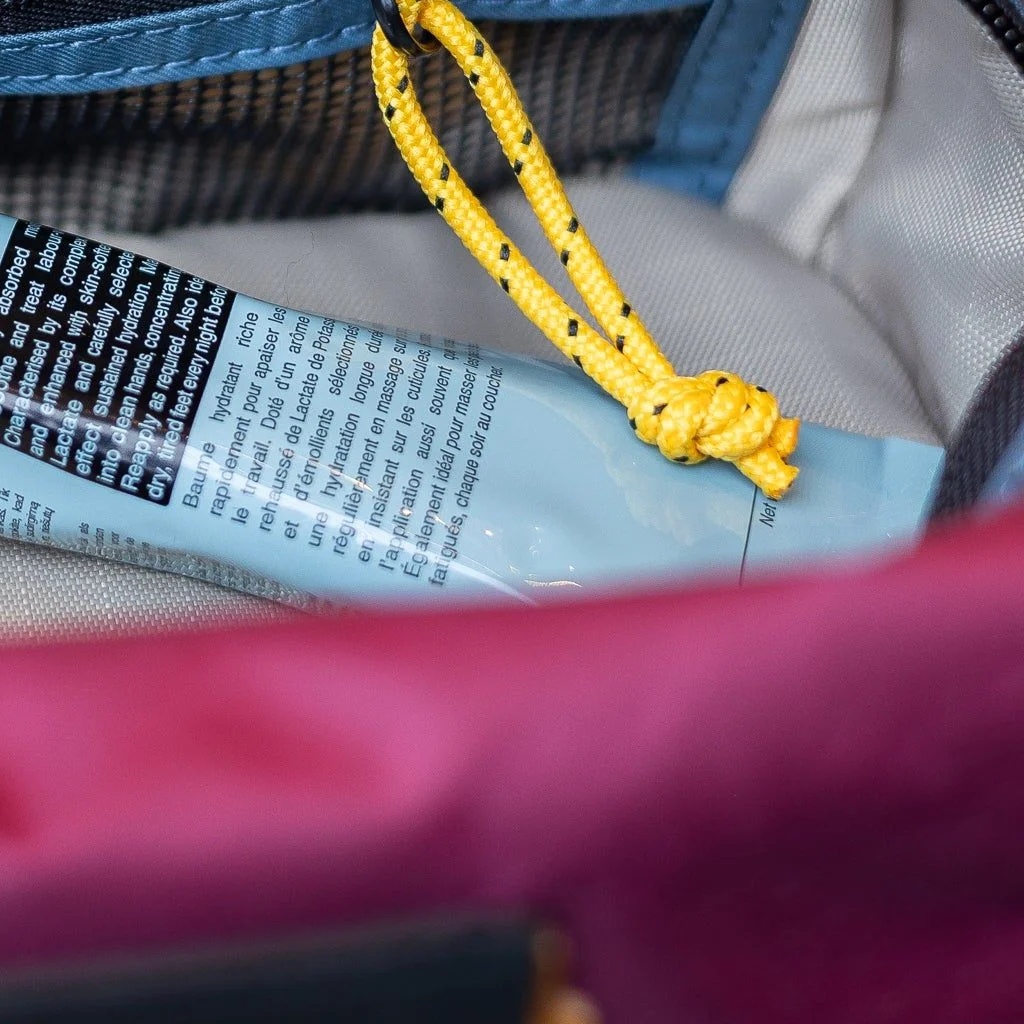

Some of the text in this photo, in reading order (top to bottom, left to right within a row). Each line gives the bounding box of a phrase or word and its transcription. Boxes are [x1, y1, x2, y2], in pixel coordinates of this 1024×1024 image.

[10, 321, 30, 348] and
[20, 281, 45, 313] treat
[34, 233, 62, 272] labour-
[47, 294, 67, 311] its
[175, 298, 198, 331] Also
[31, 245, 111, 456] and enhanced with skin-softe
[38, 317, 61, 334] by
[195, 317, 218, 353] night
[50, 253, 134, 467] Lactate and carefully selecte
[76, 423, 102, 474] effect
[93, 346, 128, 415] sustained
[115, 282, 151, 344] hydration.
[96, 269, 180, 482] into clean hands, concentratin
[156, 335, 186, 390] required.
[184, 353, 209, 389] every
[377, 358, 404, 414] massage
[407, 350, 431, 400] cuticules.
[4, 339, 50, 446] Characterised
[149, 392, 166, 411] as
[169, 390, 194, 417] feet
[182, 313, 258, 508] Baume hydratant riche
[210, 308, 286, 516] rapidement pour apaiser les
[231, 508, 249, 524] le
[241, 441, 271, 494] travail.
[260, 397, 284, 430] Doté
[288, 316, 310, 354] arôme
[396, 406, 415, 426] les
[417, 422, 436, 459] aussi
[429, 366, 452, 415] souvent
[120, 413, 162, 491] Reapply
[157, 418, 184, 459] tired
[259, 317, 337, 531] rehaussé de Lactate de Potass
[284, 520, 299, 539] et
[328, 325, 359, 395] sélectionnés
[308, 513, 328, 547] une
[320, 413, 360, 497] hydratation
[349, 362, 375, 404] longue
[371, 417, 385, 434] en
[392, 430, 407, 453] sur
[12, 492, 25, 513] kad
[146, 467, 173, 499] dry,
[333, 438, 379, 555] régulièrement
[365, 459, 399, 528] insistant
[401, 484, 446, 578] Également
[433, 449, 455, 482] idéal
[446, 417, 464, 451] pour
[456, 368, 477, 416] masser
[428, 366, 502, 586] fatigués, chaque soir au coucher.
[759, 502, 776, 527] Net
[358, 540, 374, 562] en
